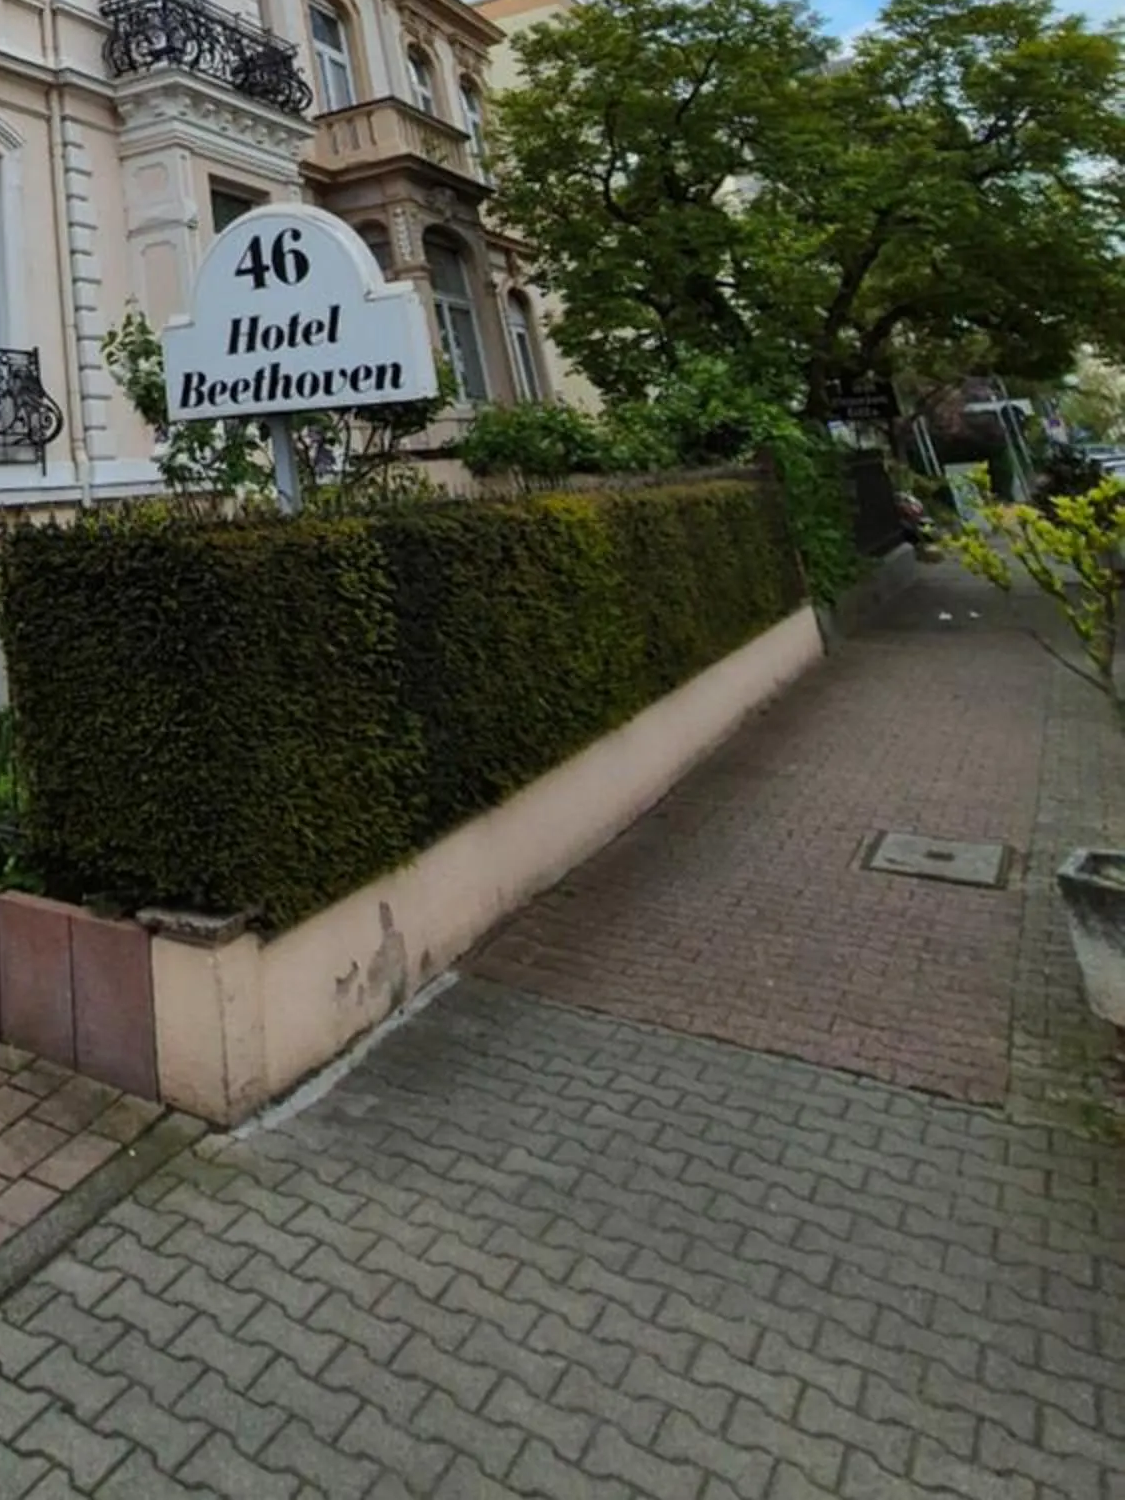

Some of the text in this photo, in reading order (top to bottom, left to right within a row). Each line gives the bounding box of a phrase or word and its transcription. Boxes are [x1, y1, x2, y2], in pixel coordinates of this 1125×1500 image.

[234, 227, 310, 290] 46
[227, 304, 341, 356] Hotel
[179, 361, 403, 410] Beethoven
